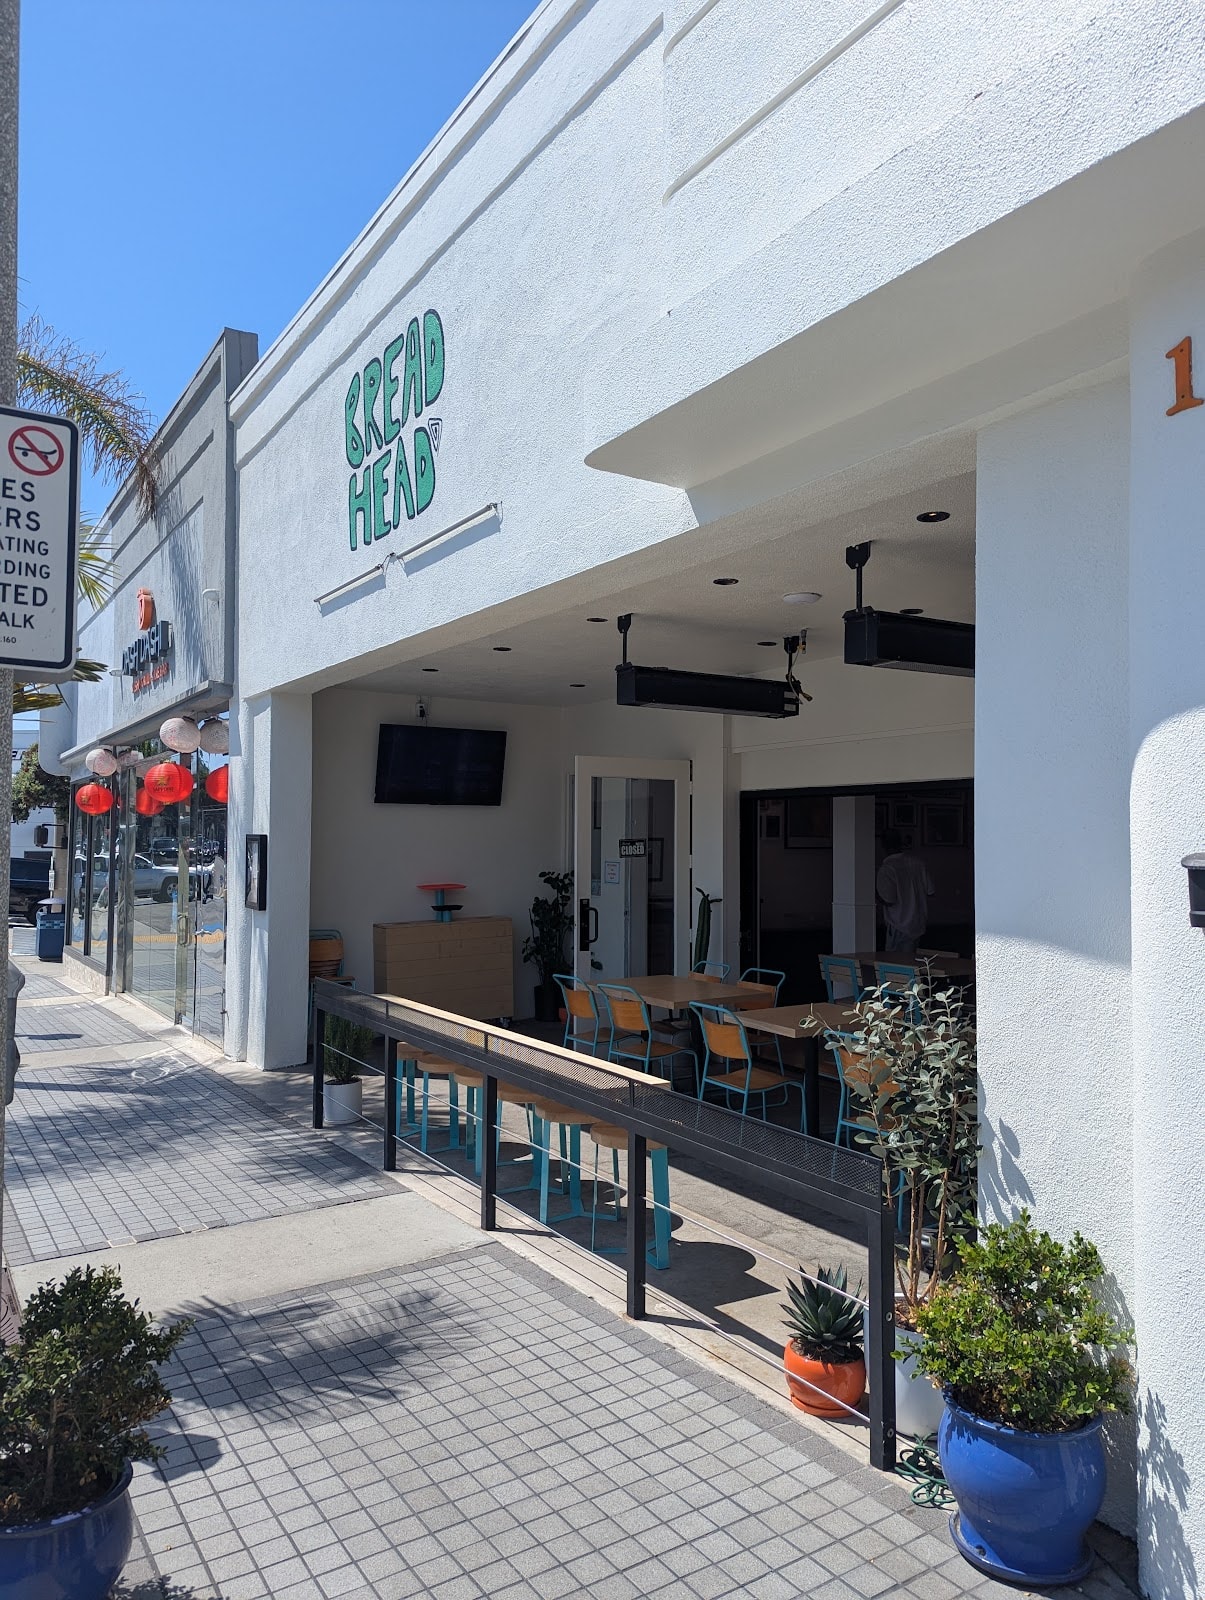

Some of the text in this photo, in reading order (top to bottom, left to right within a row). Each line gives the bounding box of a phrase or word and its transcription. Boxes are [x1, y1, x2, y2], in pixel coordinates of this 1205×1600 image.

[1165, 336, 1204, 416] 1
[345, 309, 445, 469] BREAD
[2, 478, 35, 502] ES
[348, 427, 436, 551] HEAD
[0, 507, 40, 531] RS
[0, 559, 50, 579] DING
[0, 582, 48, 607] TED
[0, 611, 35, 630] ALK
[621, 845, 645, 855] CLOSED
